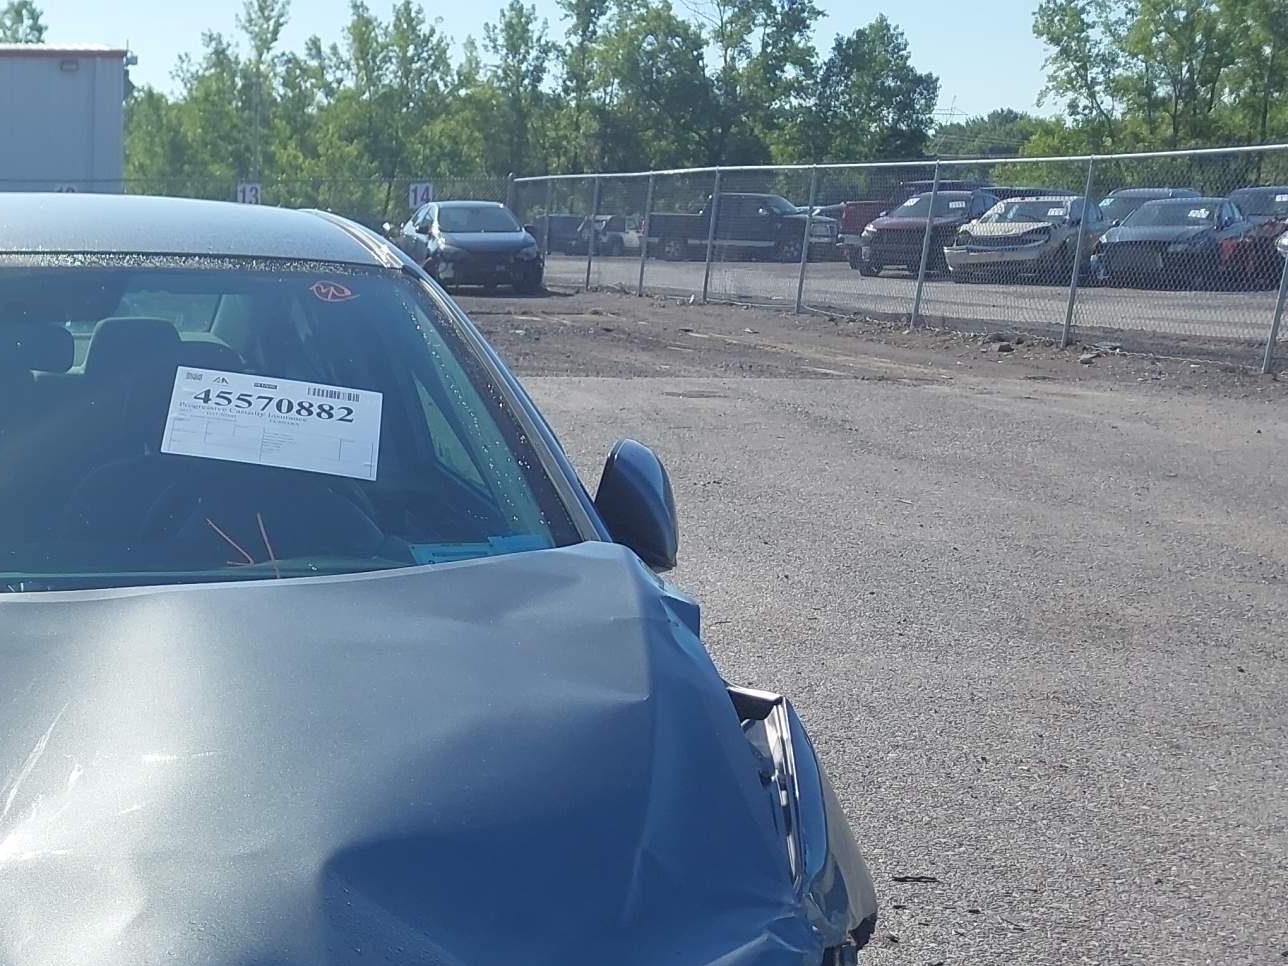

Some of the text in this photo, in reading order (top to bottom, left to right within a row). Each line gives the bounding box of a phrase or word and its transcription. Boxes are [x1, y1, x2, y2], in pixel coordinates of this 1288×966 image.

[239, 186, 258, 204] 13
[412, 185, 431, 206] 14
[193, 388, 355, 423] 45570882
